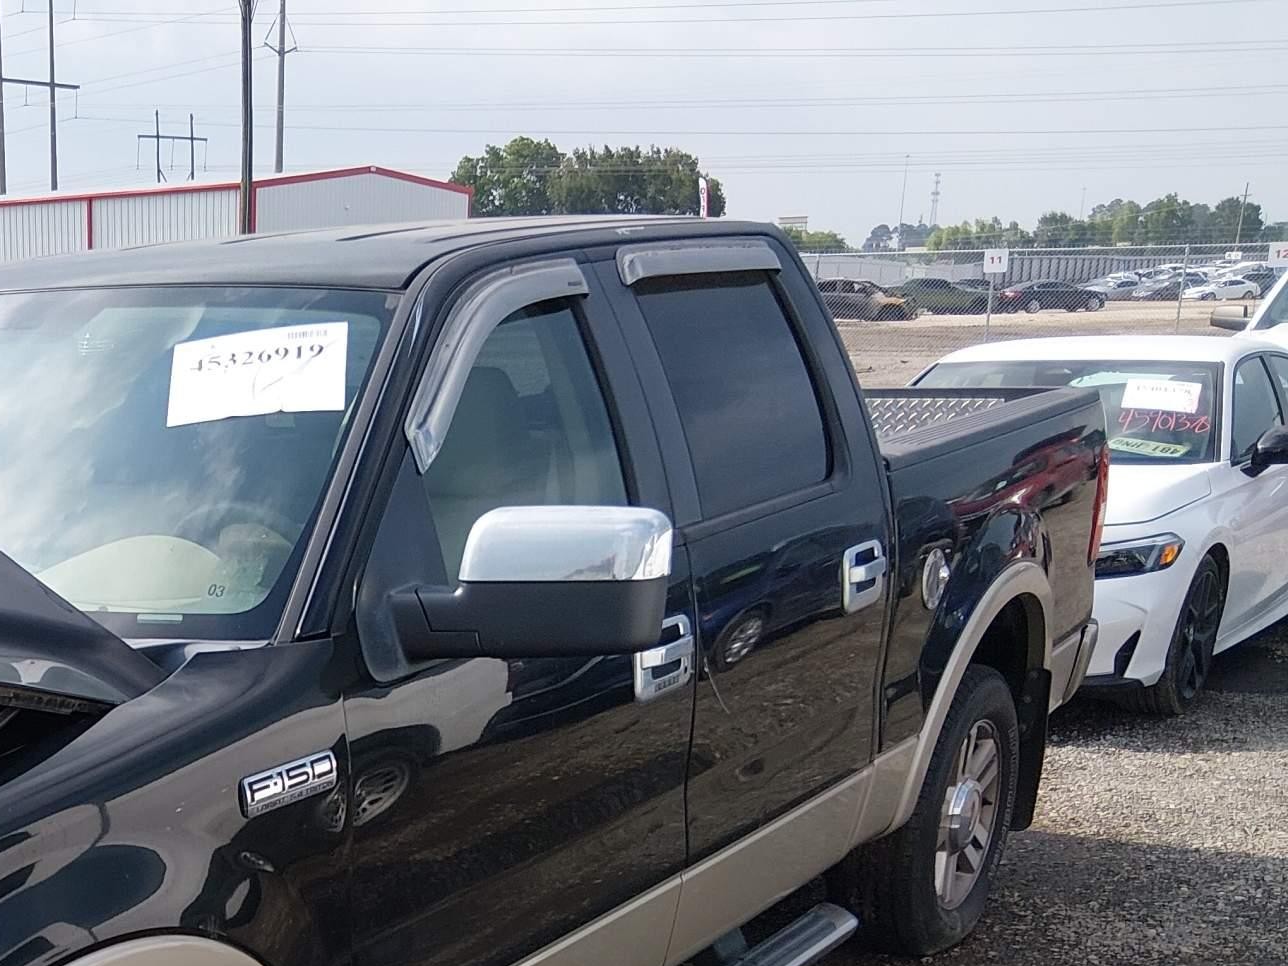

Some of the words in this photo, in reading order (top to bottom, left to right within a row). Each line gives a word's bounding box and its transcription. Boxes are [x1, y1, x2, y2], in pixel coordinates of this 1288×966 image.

[989, 256, 1002, 264] 11
[190, 343, 325, 373] 45326919
[207, 583, 226, 598] 03
